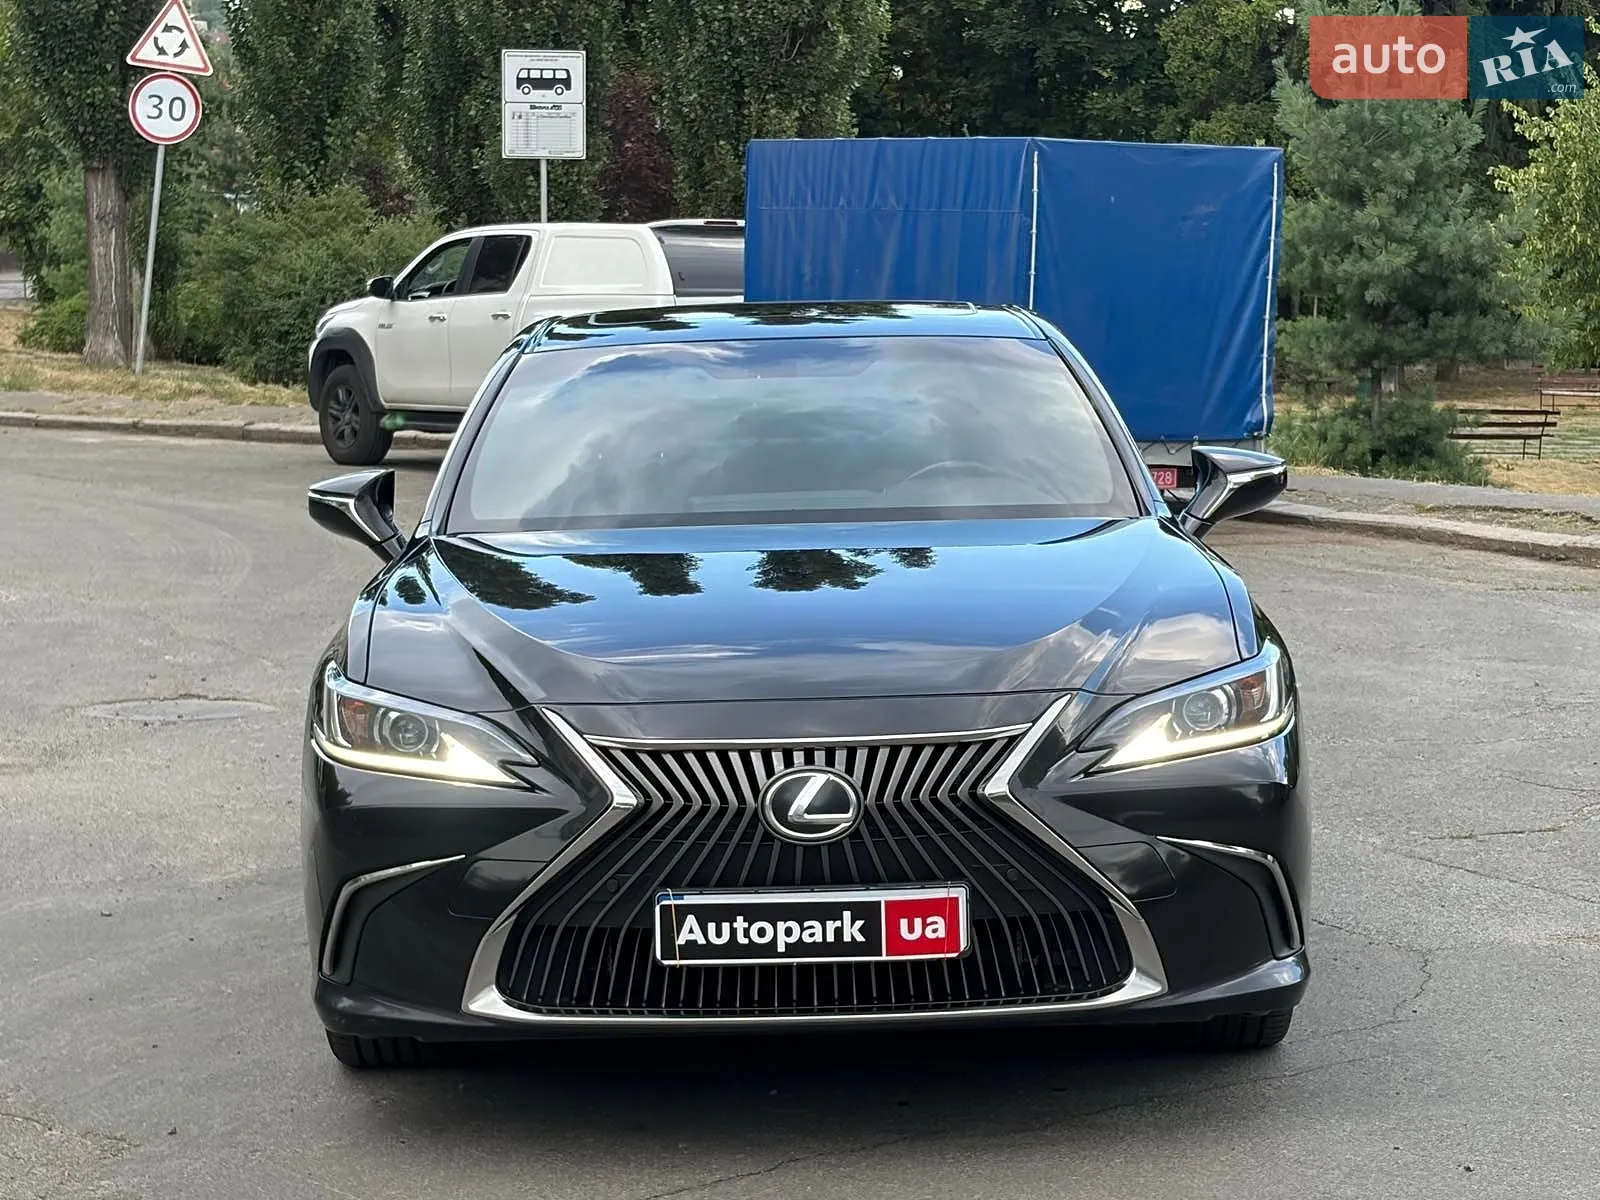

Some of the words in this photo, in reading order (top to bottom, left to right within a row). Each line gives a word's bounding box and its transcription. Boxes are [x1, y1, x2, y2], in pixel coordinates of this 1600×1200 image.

[146, 94, 187, 122] 30
[676, 911, 866, 953] Autopark
[899, 914, 946, 941] ua
